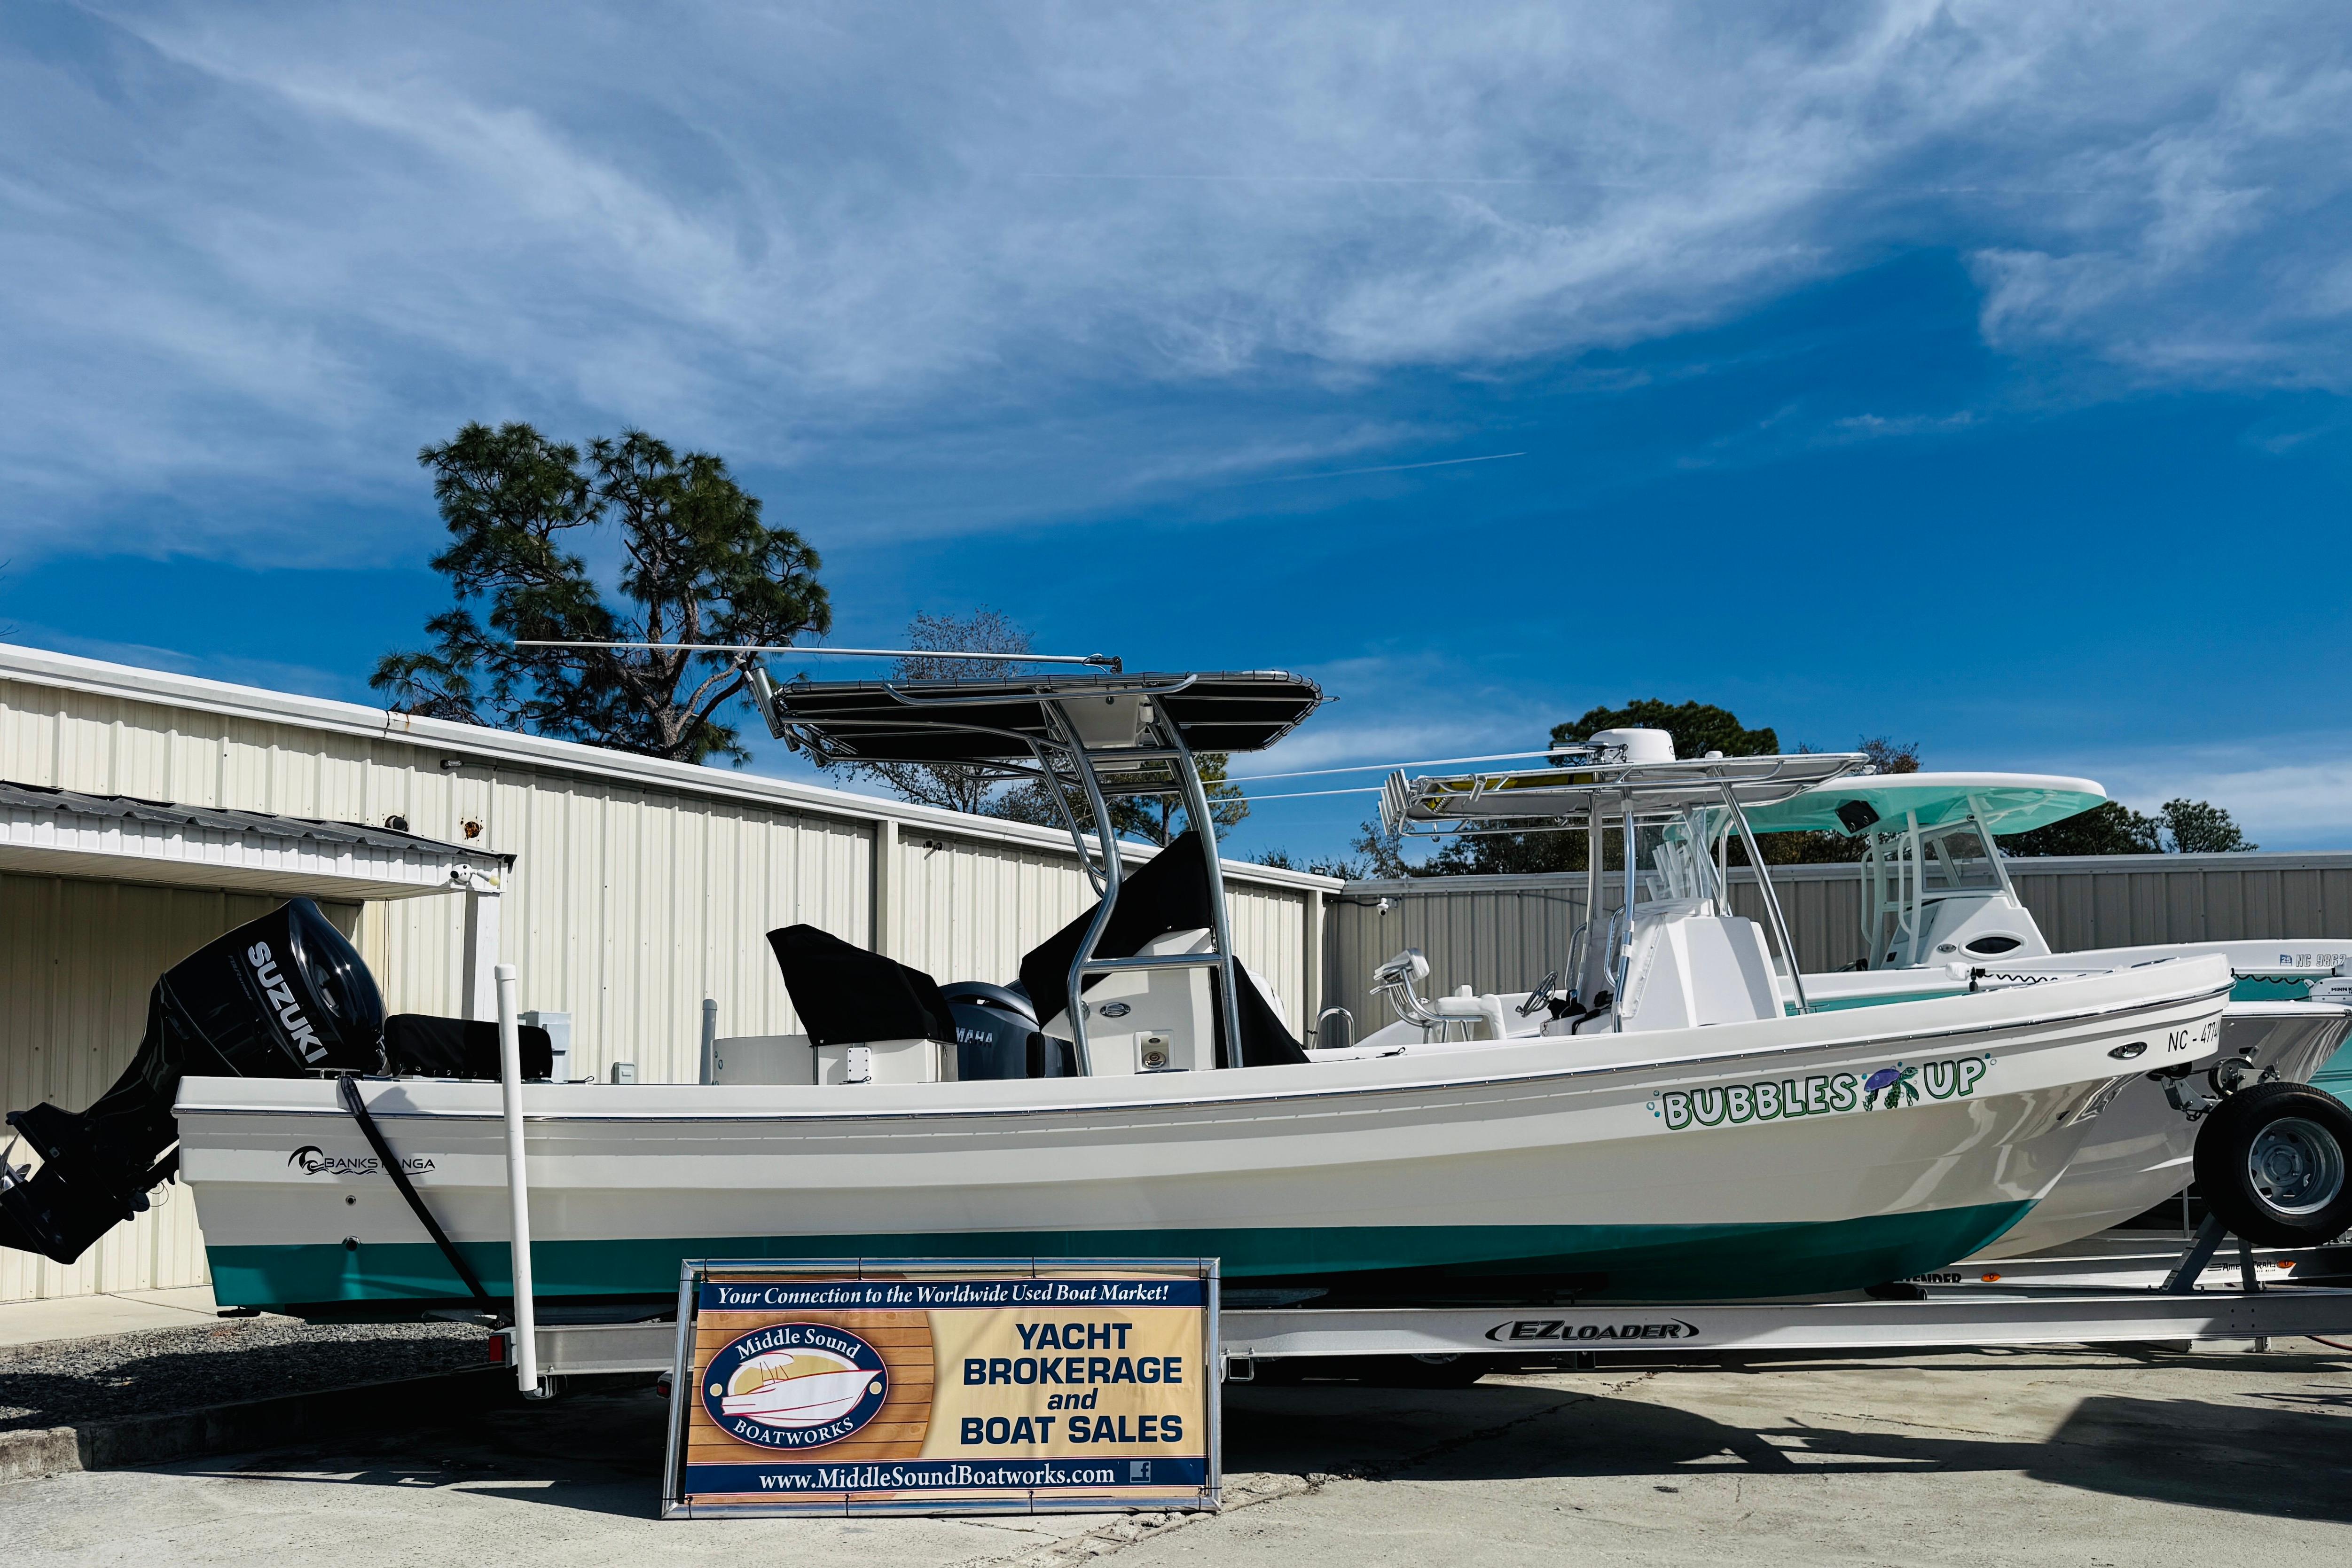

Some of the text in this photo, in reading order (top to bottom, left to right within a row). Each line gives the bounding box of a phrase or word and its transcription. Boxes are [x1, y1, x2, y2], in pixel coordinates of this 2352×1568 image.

[2296, 954, 2311, 967] NC
[248, 941, 328, 1064] SUZUKI
[956, 1027, 993, 1043] MAHA
[2168, 1030, 2188, 1052] NC
[1662, 1057, 1986, 1130] BUBBLES UP
[324, 1158, 378, 1168] BANKS
[718, 1283, 1169, 1304] Your Connection to the Worldwide Used Boat Market!
[735, 1328, 862, 1360] Middle Sound
[1015, 1323, 1132, 1350] YACHT
[964, 1356, 1182, 1385] BROKERAGE
[1047, 1388, 1098, 1410] and
[733, 1417, 854, 1445] BOATWORKS
[961, 1415, 1183, 1445] BOAT SALES
[759, 1463, 1115, 1490] www.MiddleSoundBoatworks.com
